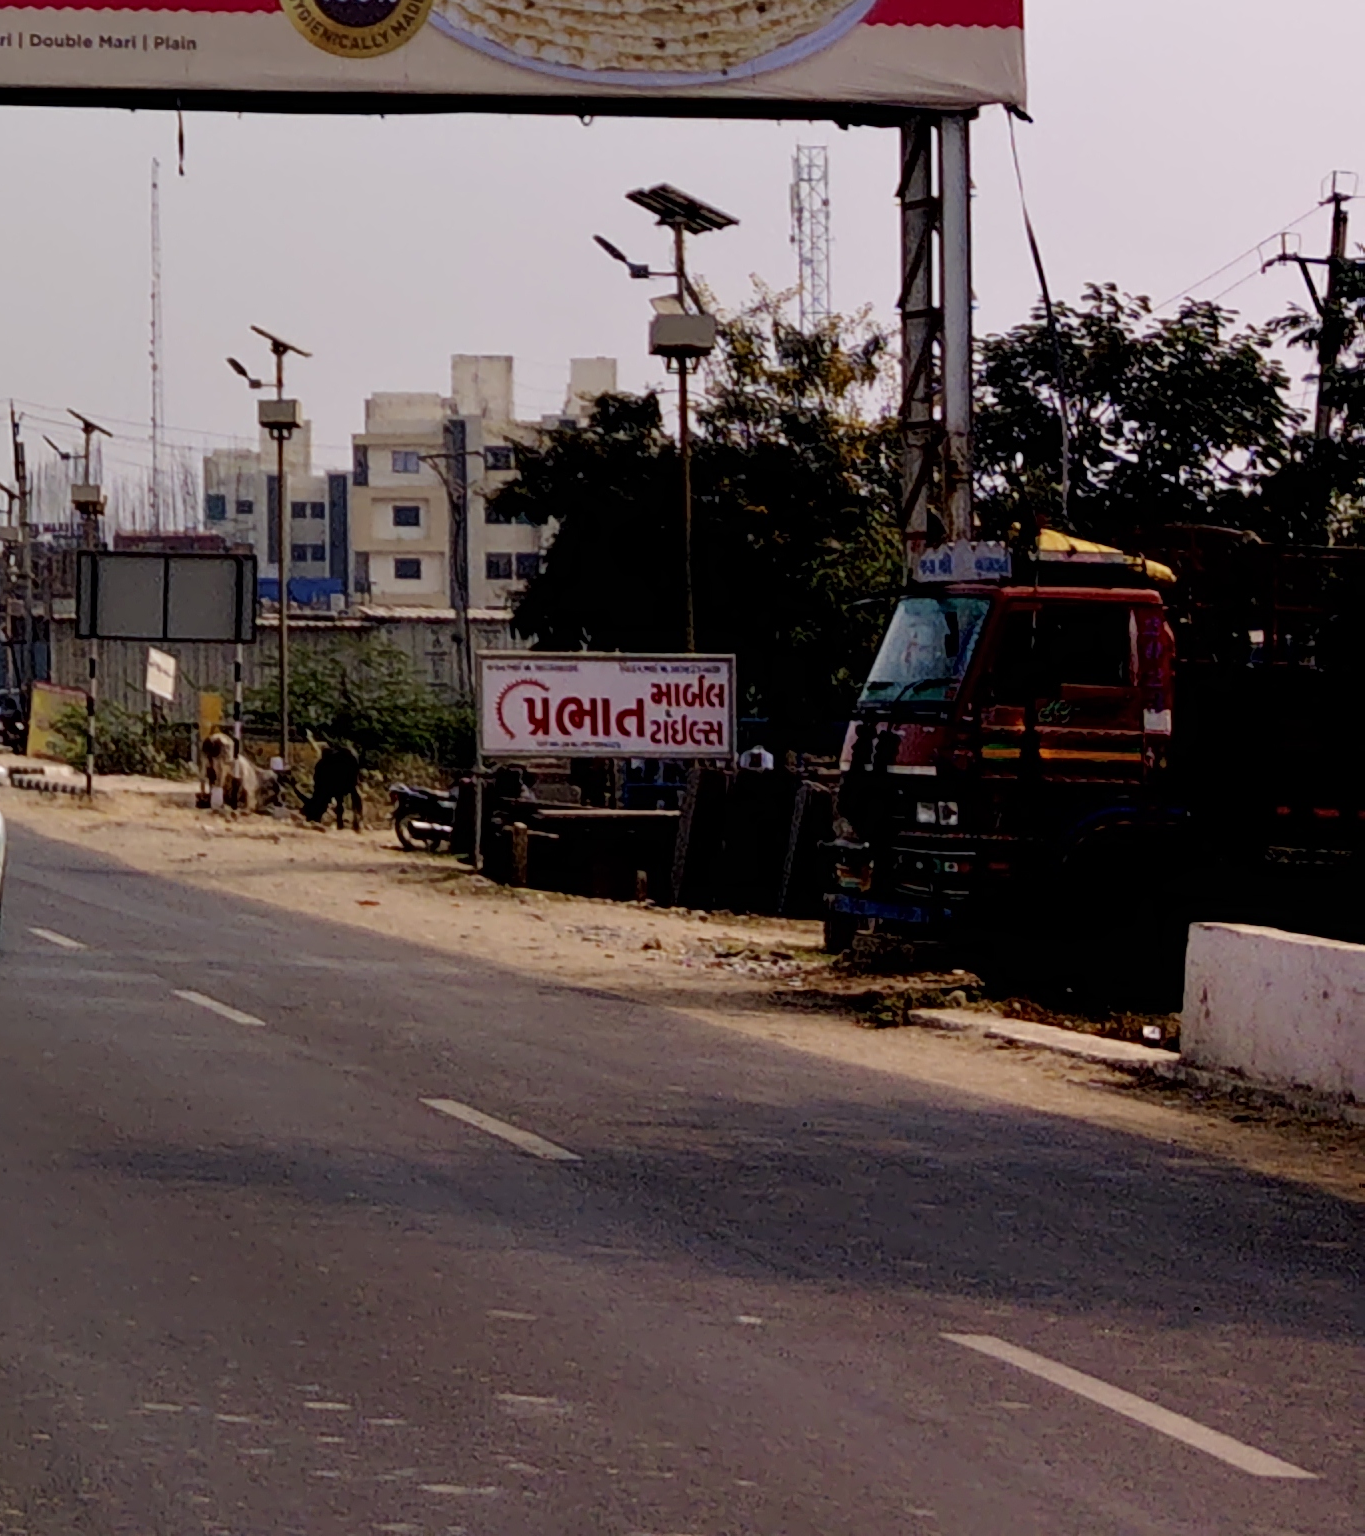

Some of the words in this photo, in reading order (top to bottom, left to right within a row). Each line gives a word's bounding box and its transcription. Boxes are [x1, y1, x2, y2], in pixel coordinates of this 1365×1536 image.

[29, 33, 92, 50] Double
[98, 35, 135, 52] Mari
[154, 36, 197, 53] Plain
[651, 676, 725, 709] માર્બલ
[524, 696, 645, 737] પ્રભાત
